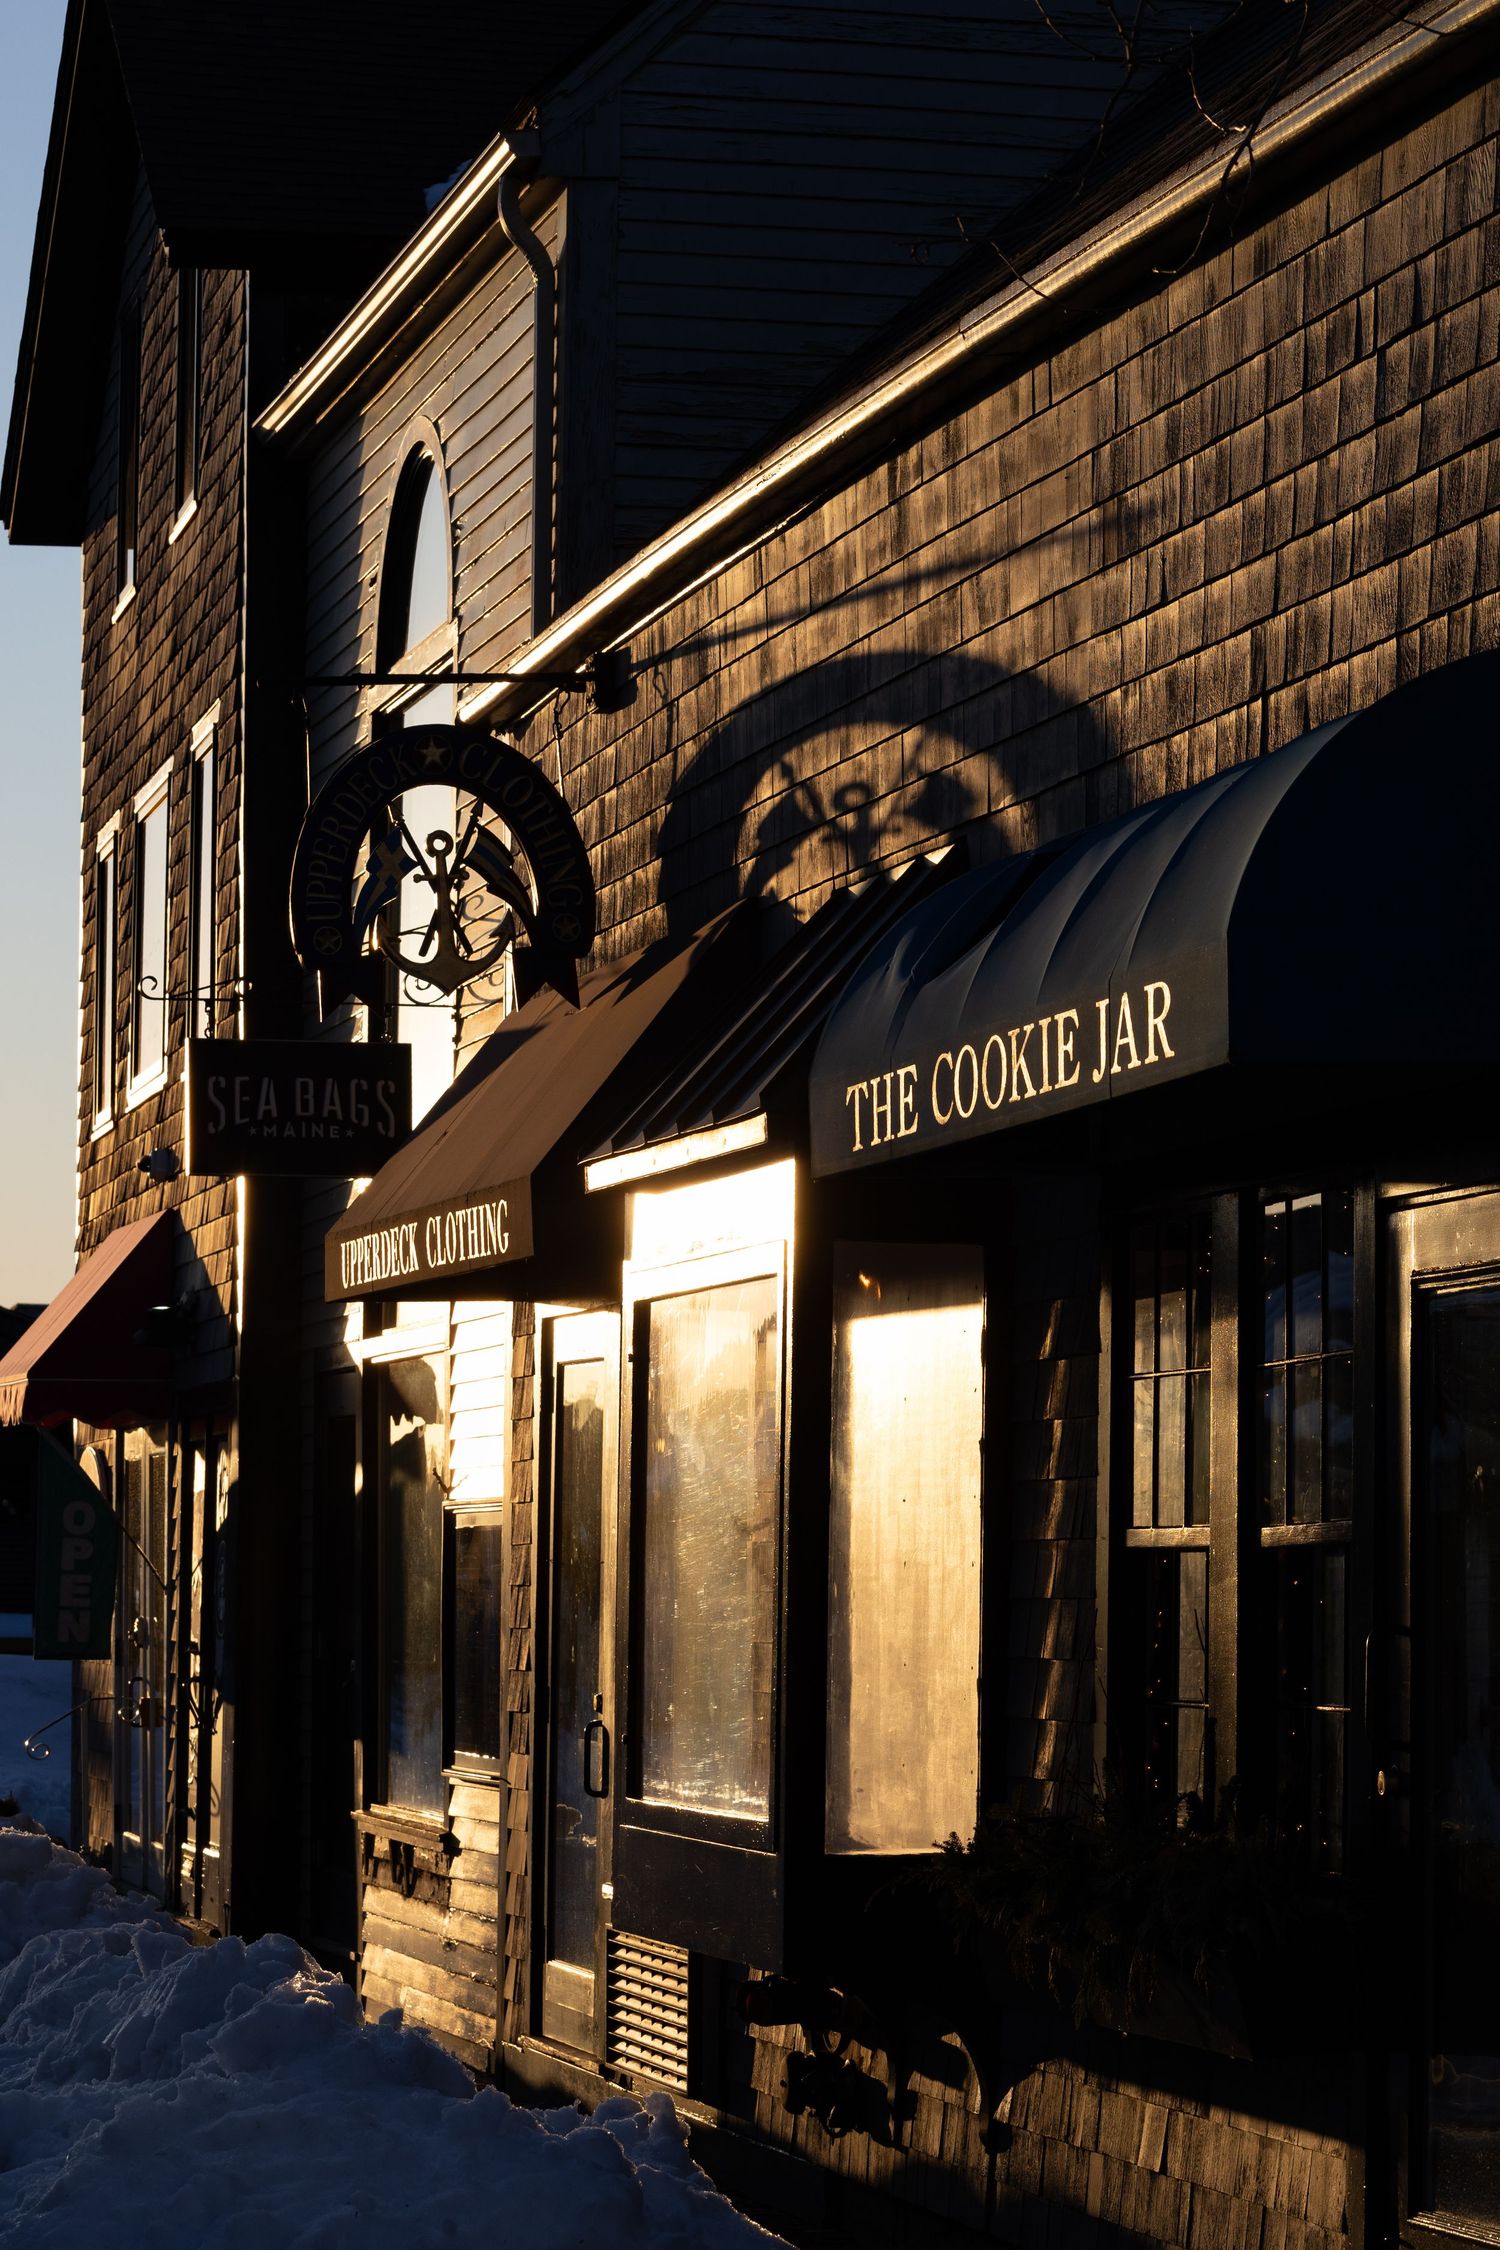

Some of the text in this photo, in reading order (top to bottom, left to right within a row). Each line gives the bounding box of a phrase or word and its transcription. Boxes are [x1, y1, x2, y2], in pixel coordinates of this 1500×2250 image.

[305, 742, 585, 922] UPPERDECK CLOTHING
[207, 1075, 396, 1138] SEA BAGS
[845, 980, 1175, 1152] THE COOKIE JAR
[262, 1123, 342, 1139] MAINE
[340, 1199, 509, 1289] UPPERDECK CLOTHING
[56, 1501, 97, 1643] OPEN
